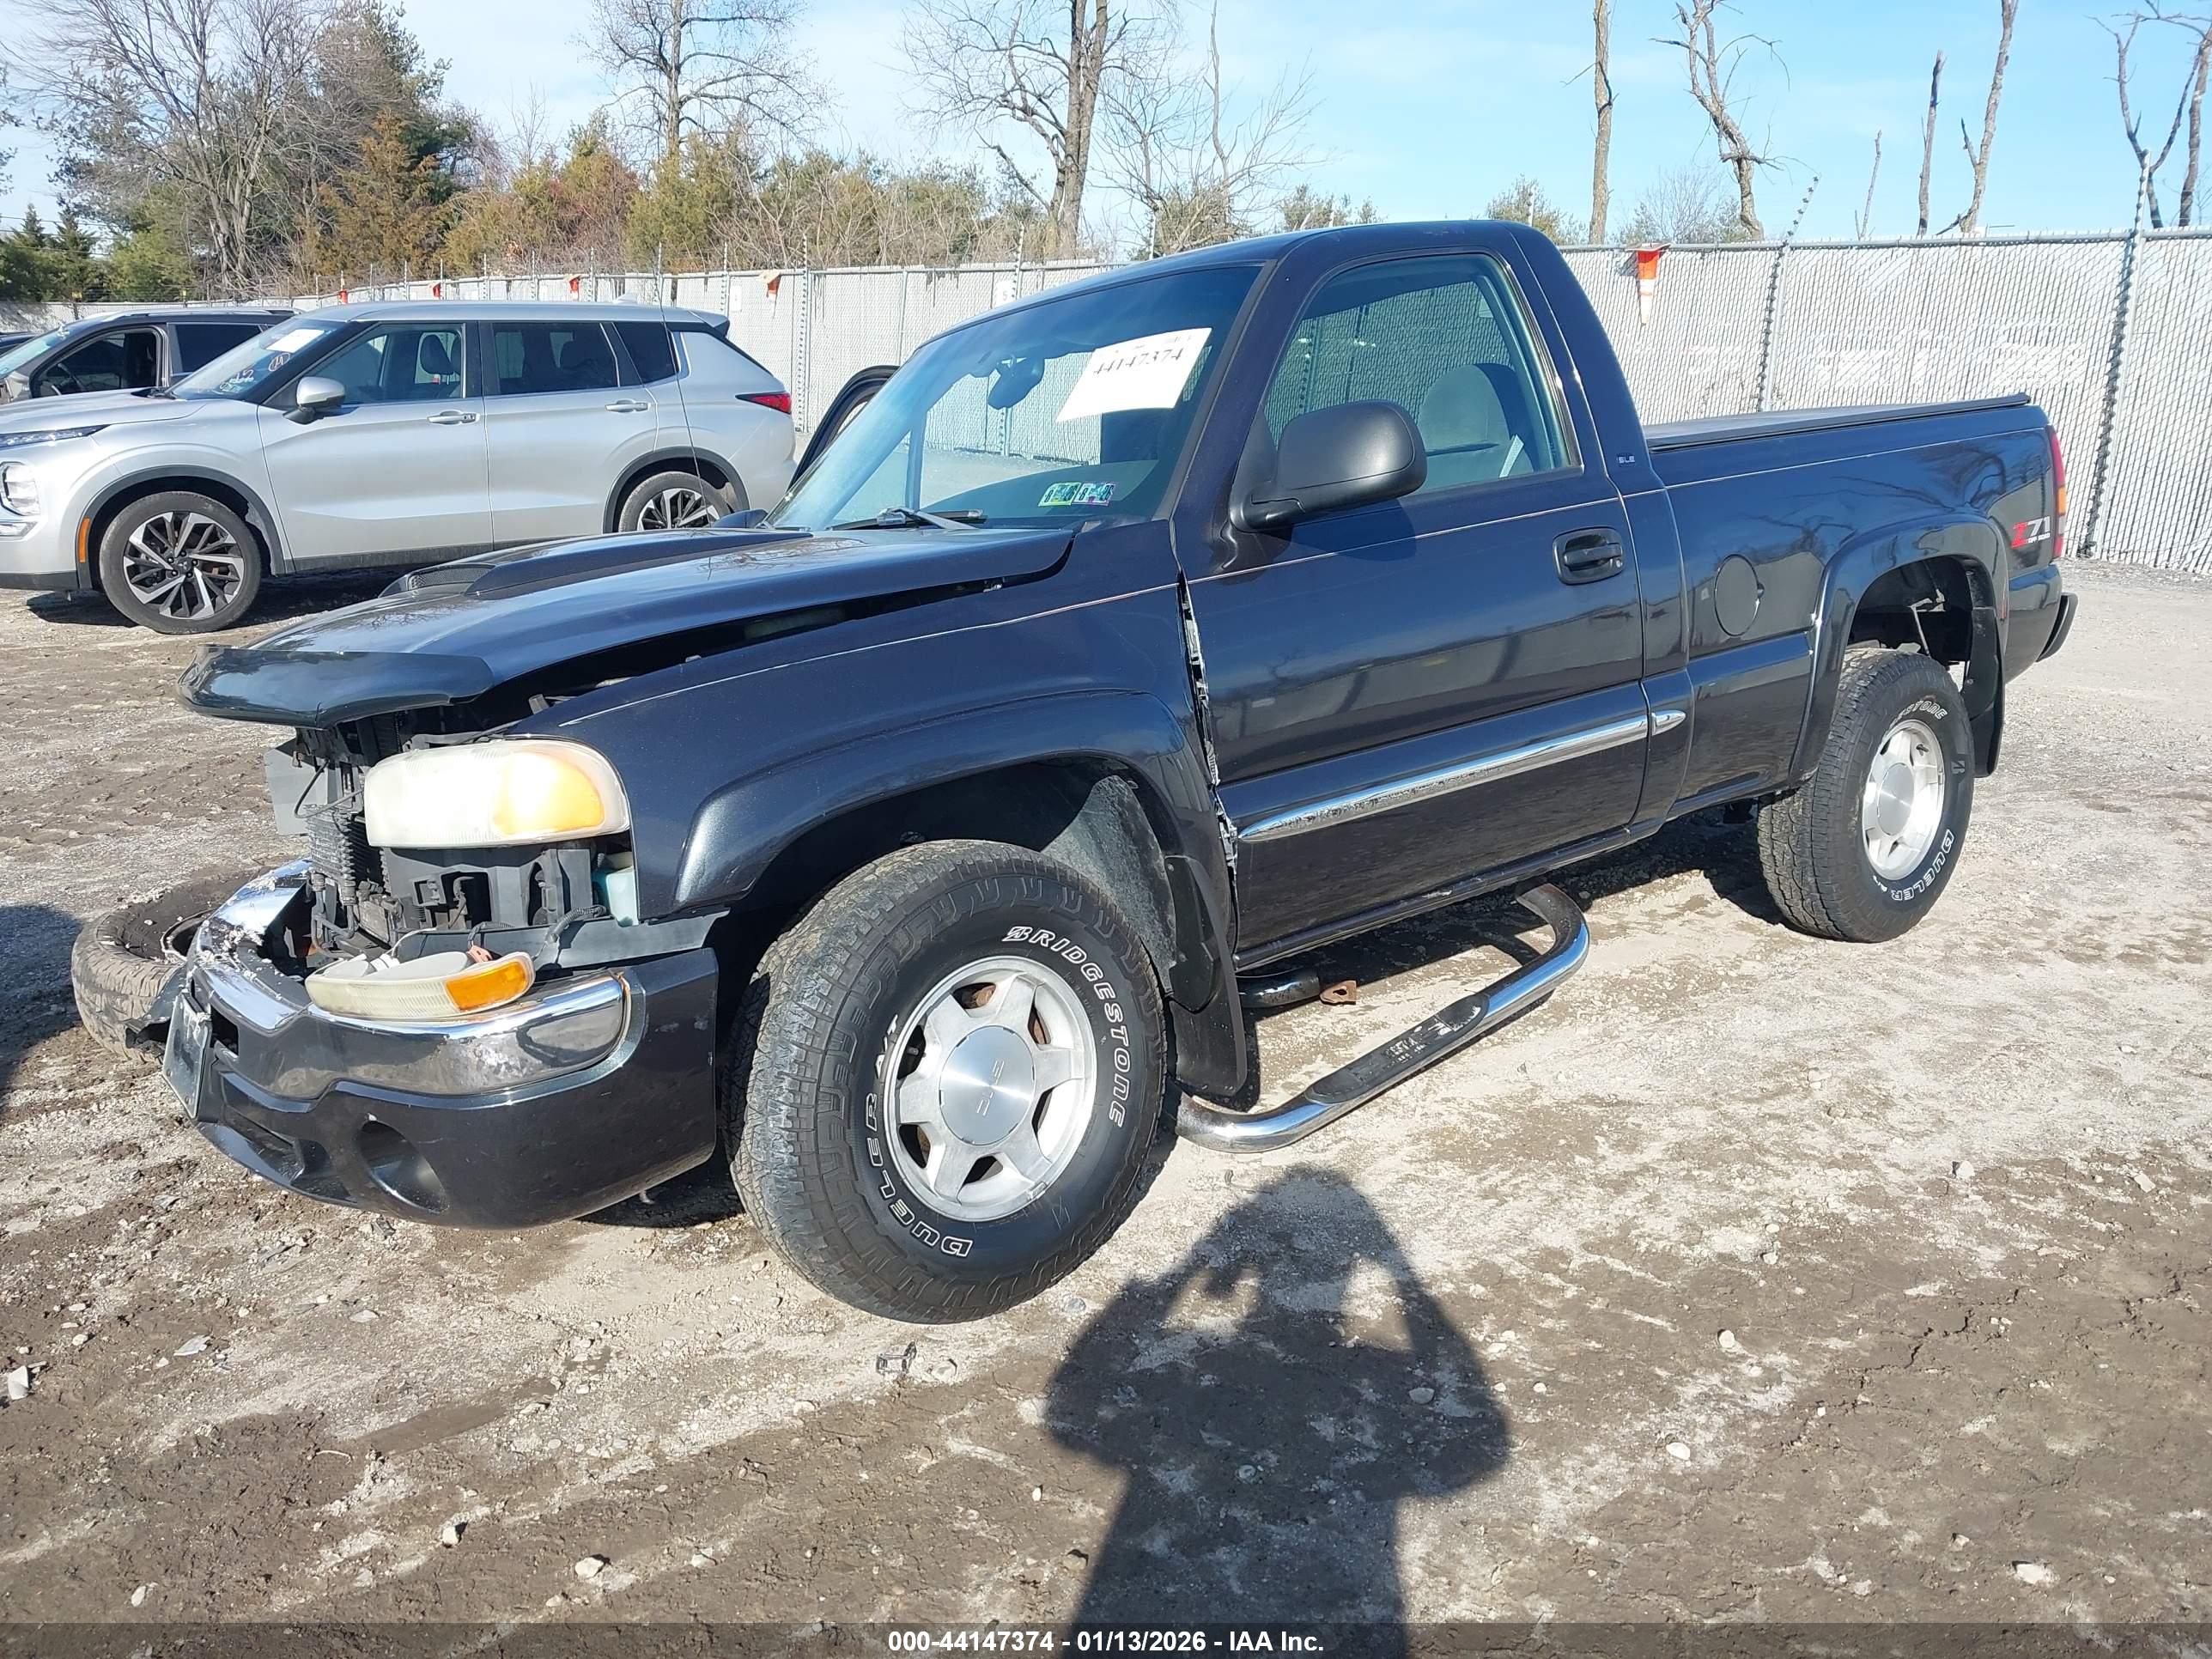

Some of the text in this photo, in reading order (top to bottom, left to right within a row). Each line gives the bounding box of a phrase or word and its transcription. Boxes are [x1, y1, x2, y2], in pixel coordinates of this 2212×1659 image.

[2010, 515, 2051, 549] Z71
[1890, 829, 1955, 902] DUELER
[1001, 926, 1132, 1128] BRIDGESTONE
[866, 1091, 975, 1258] DUELER
